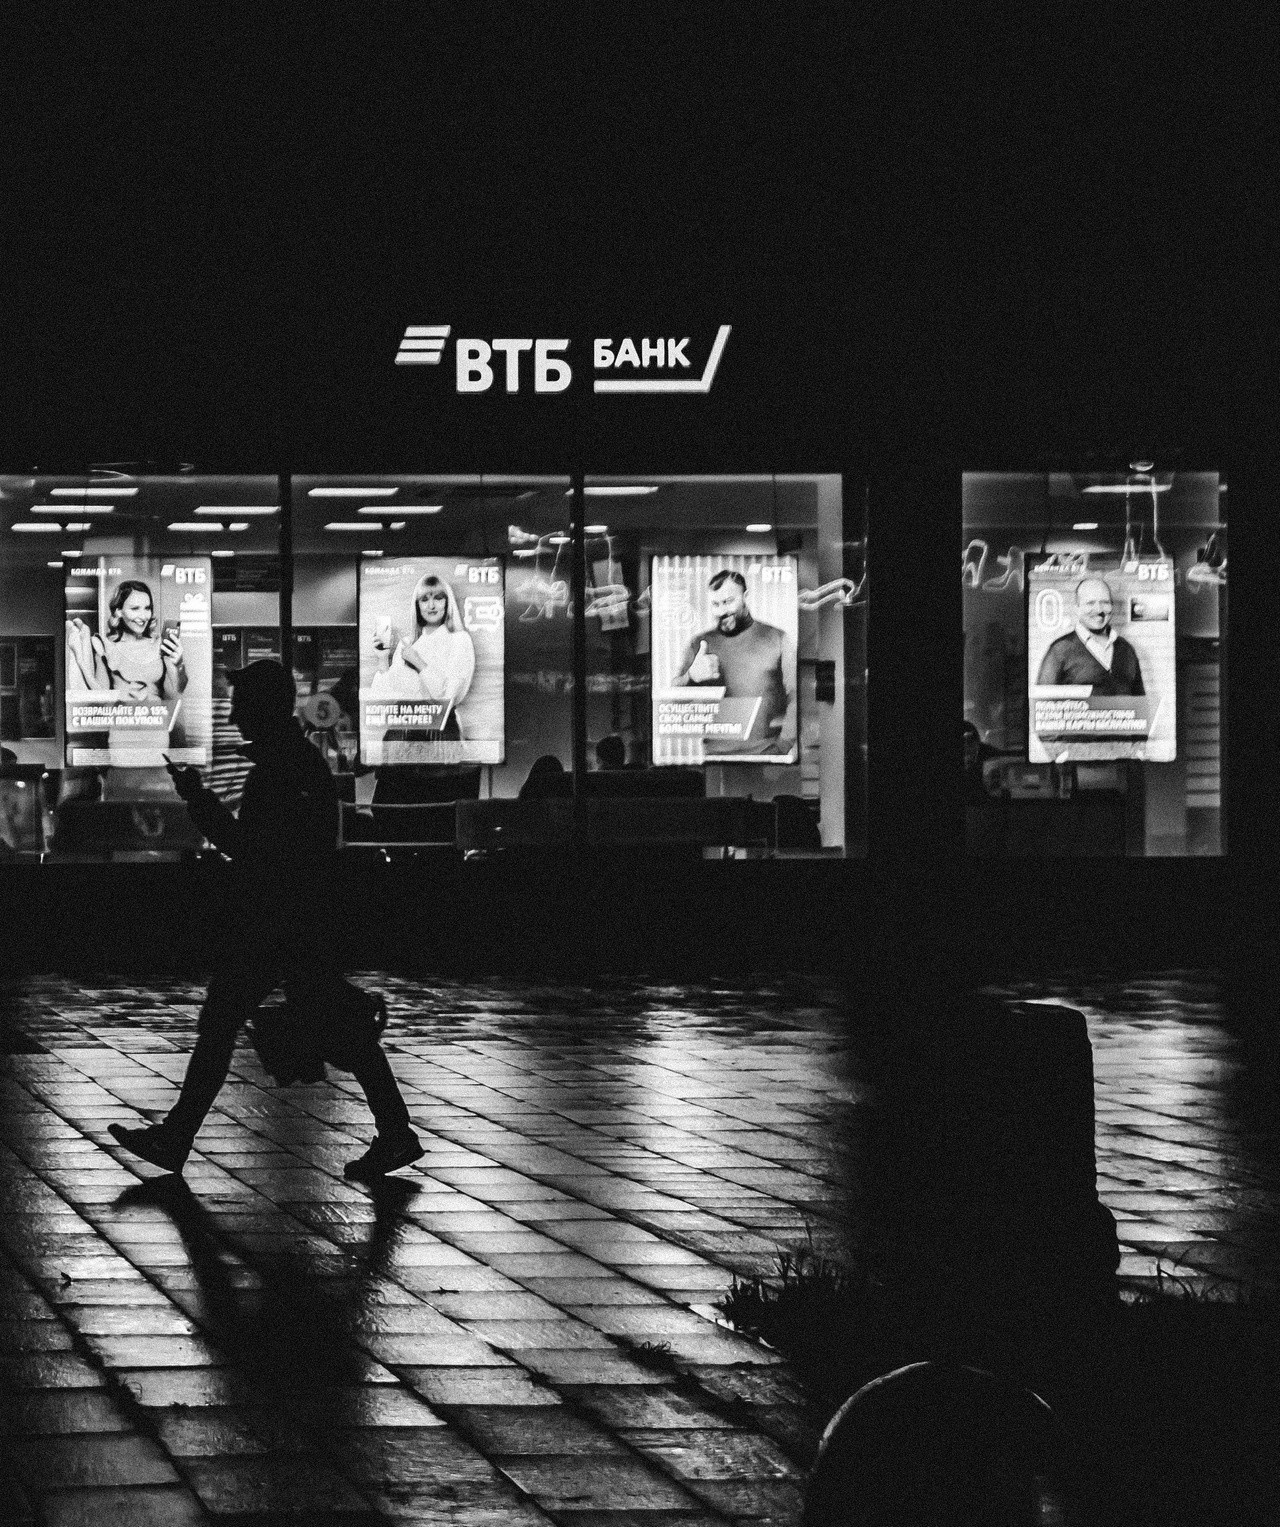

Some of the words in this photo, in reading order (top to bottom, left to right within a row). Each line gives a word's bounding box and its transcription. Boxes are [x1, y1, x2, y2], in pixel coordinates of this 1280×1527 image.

[456, 338, 572, 394] ВТБ
[593, 337, 691, 368] БАНК
[175, 567, 207, 584] ВТБ
[468, 566, 500, 583] ВТБ
[761, 566, 793, 583] ВТБ
[1138, 563, 1169, 581] ВТБ
[134, 706, 149, 716] ДО
[400, 704, 413, 714] НА
[414, 704, 443, 715] МЕЧТУ
